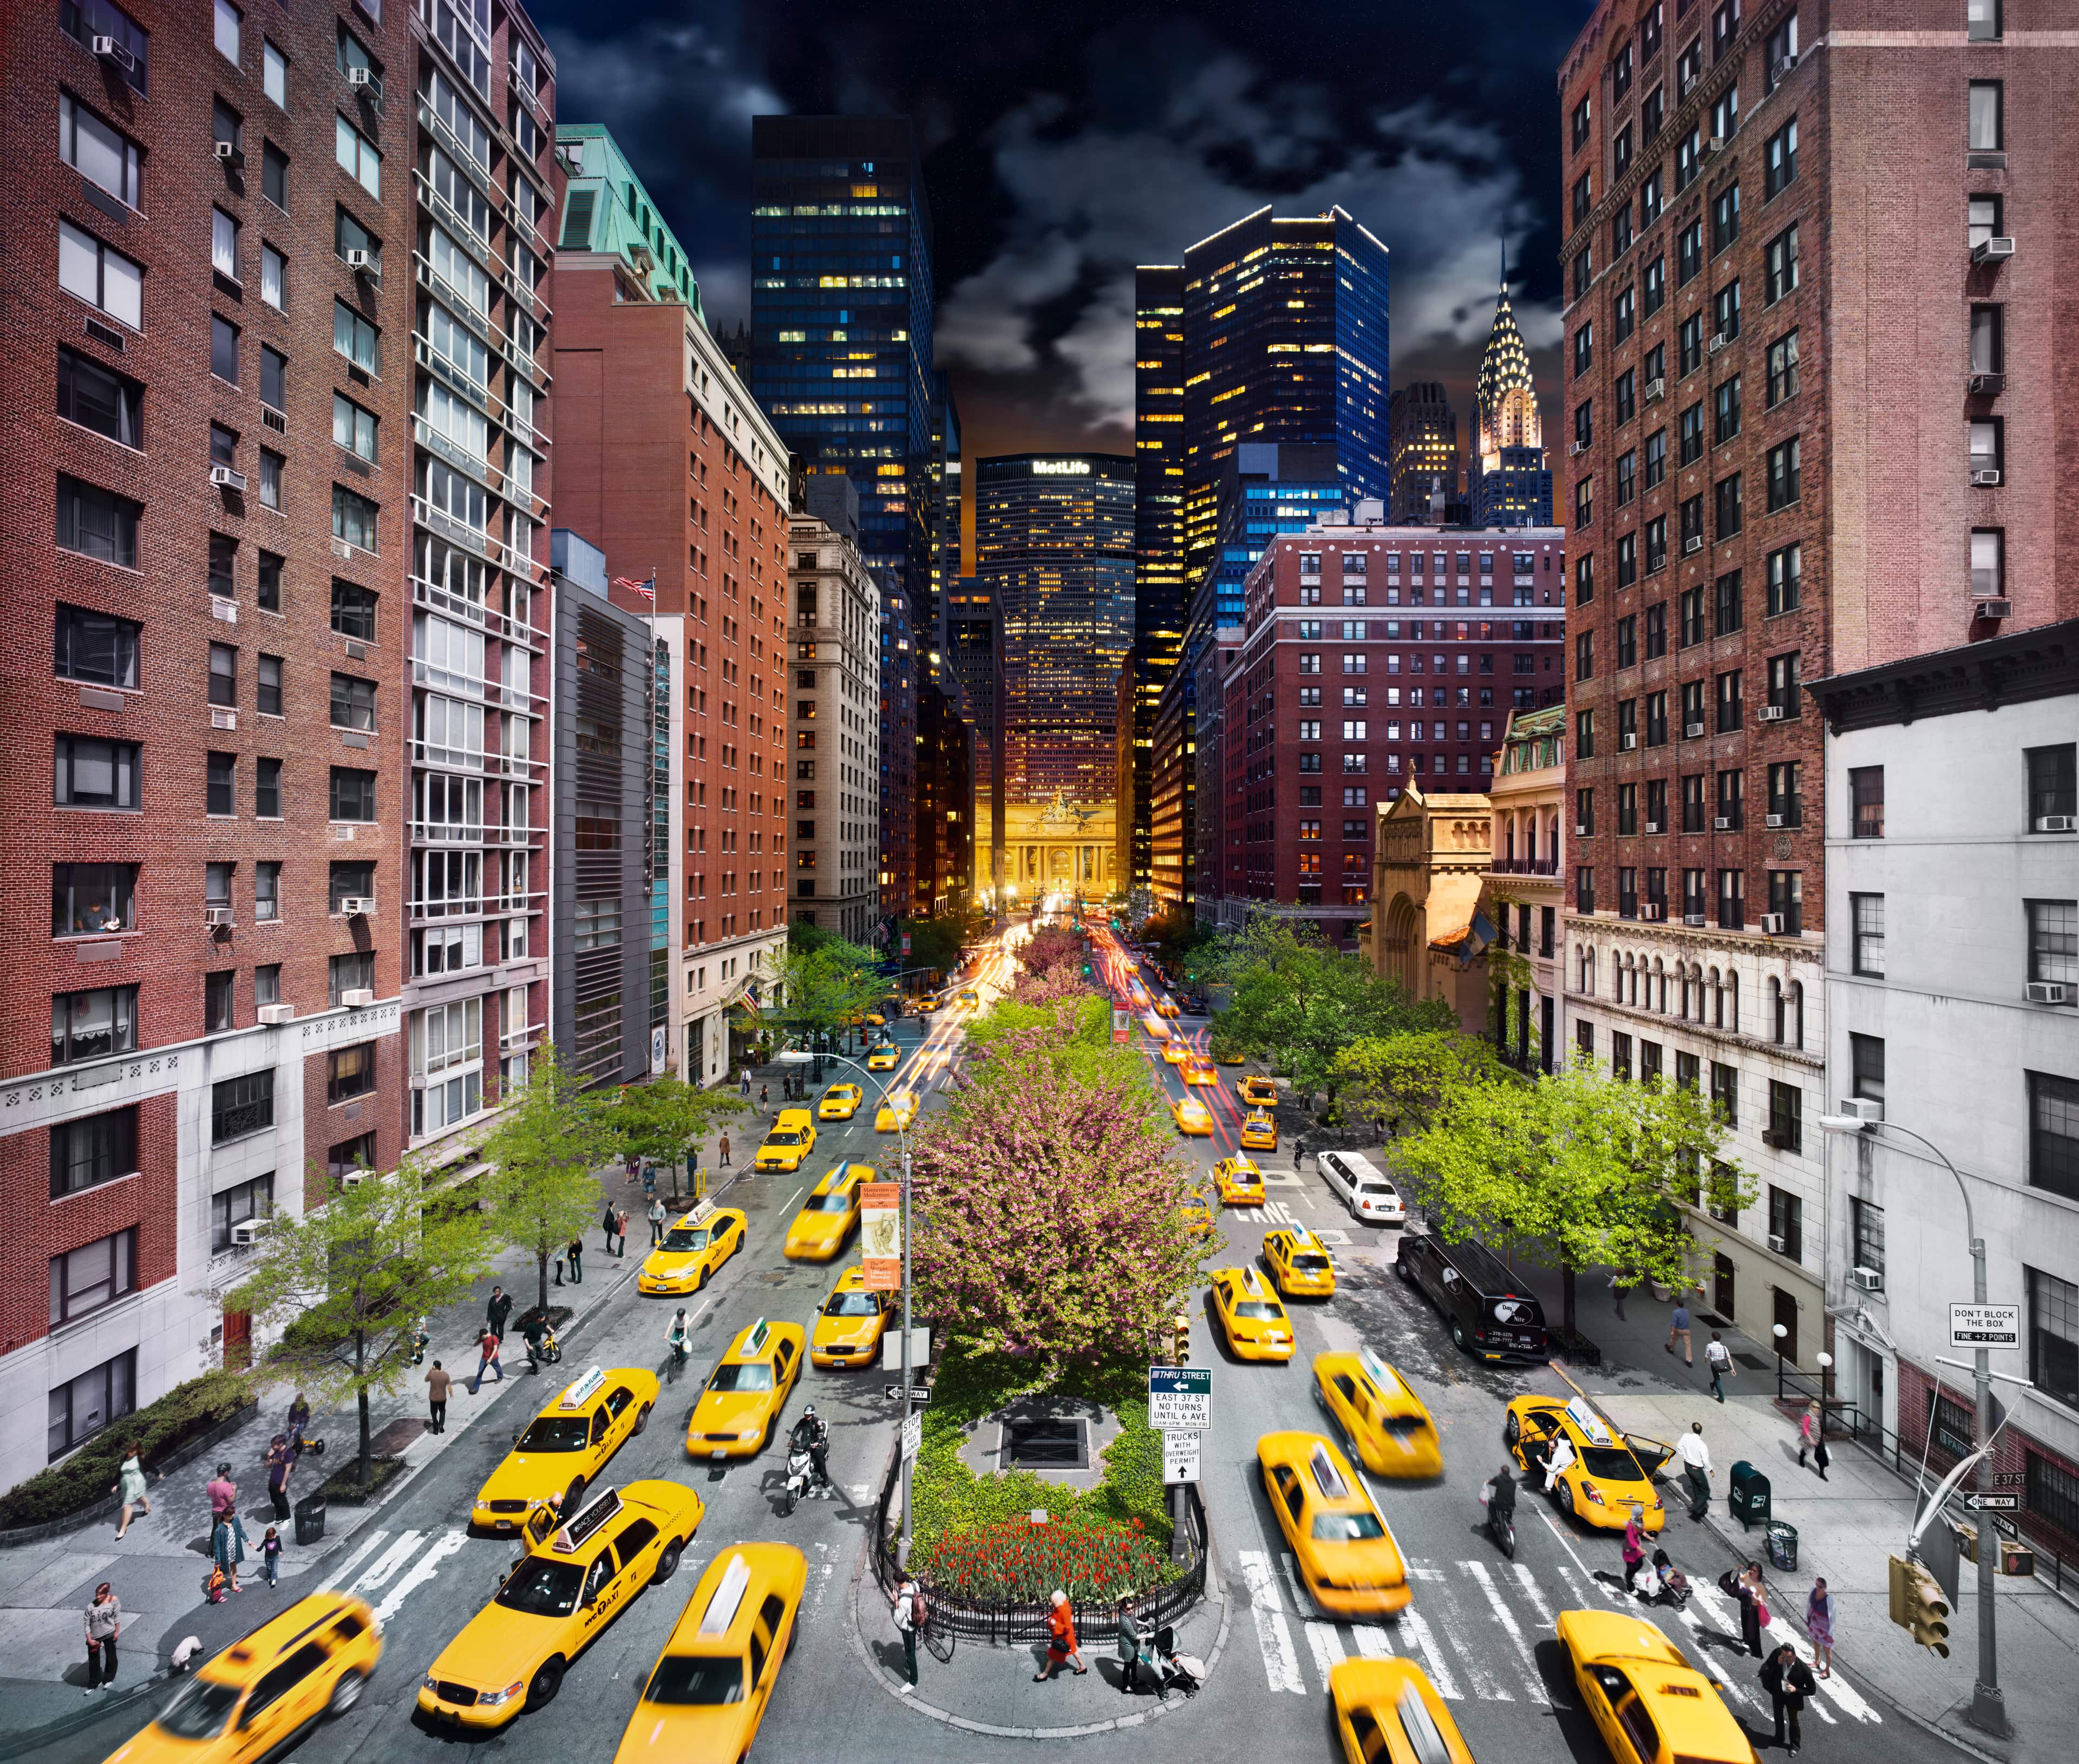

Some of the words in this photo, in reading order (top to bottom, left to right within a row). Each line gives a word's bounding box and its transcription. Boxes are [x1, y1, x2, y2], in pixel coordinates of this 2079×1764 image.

[1033, 461, 1090, 474] MetLife
[1233, 1202, 1298, 1224] LANE
[1957, 1332, 1972, 1340] FINE
[1160, 1371, 1180, 1379] THRU
[1182, 1372, 1210, 1380] STREET
[575, 1387, 585, 1399] WI-FI
[584, 1370, 602, 1389] IN-FLIGHT
[904, 1414, 920, 1432] STOP
[904, 1429, 913, 1439] HERE
[907, 1435, 916, 1445] RED
[1167, 1432, 1198, 1441] TRUCKS
[904, 1440, 919, 1455] SIGNAL
[1165, 1449, 1199, 1457] OVERWEIGHT
[1948, 1436, 1967, 1457] PARK
[1995, 1475, 1999, 1485] E
[2003, 1474, 2013, 1485] 37
[2015, 1474, 2025, 1484] ST
[574, 1515, 591, 1533] BRACE
[590, 1496, 612, 1518] YOURSELF
[1996, 1515, 2011, 1531] WAY
[585, 1612, 598, 1628] NYC
